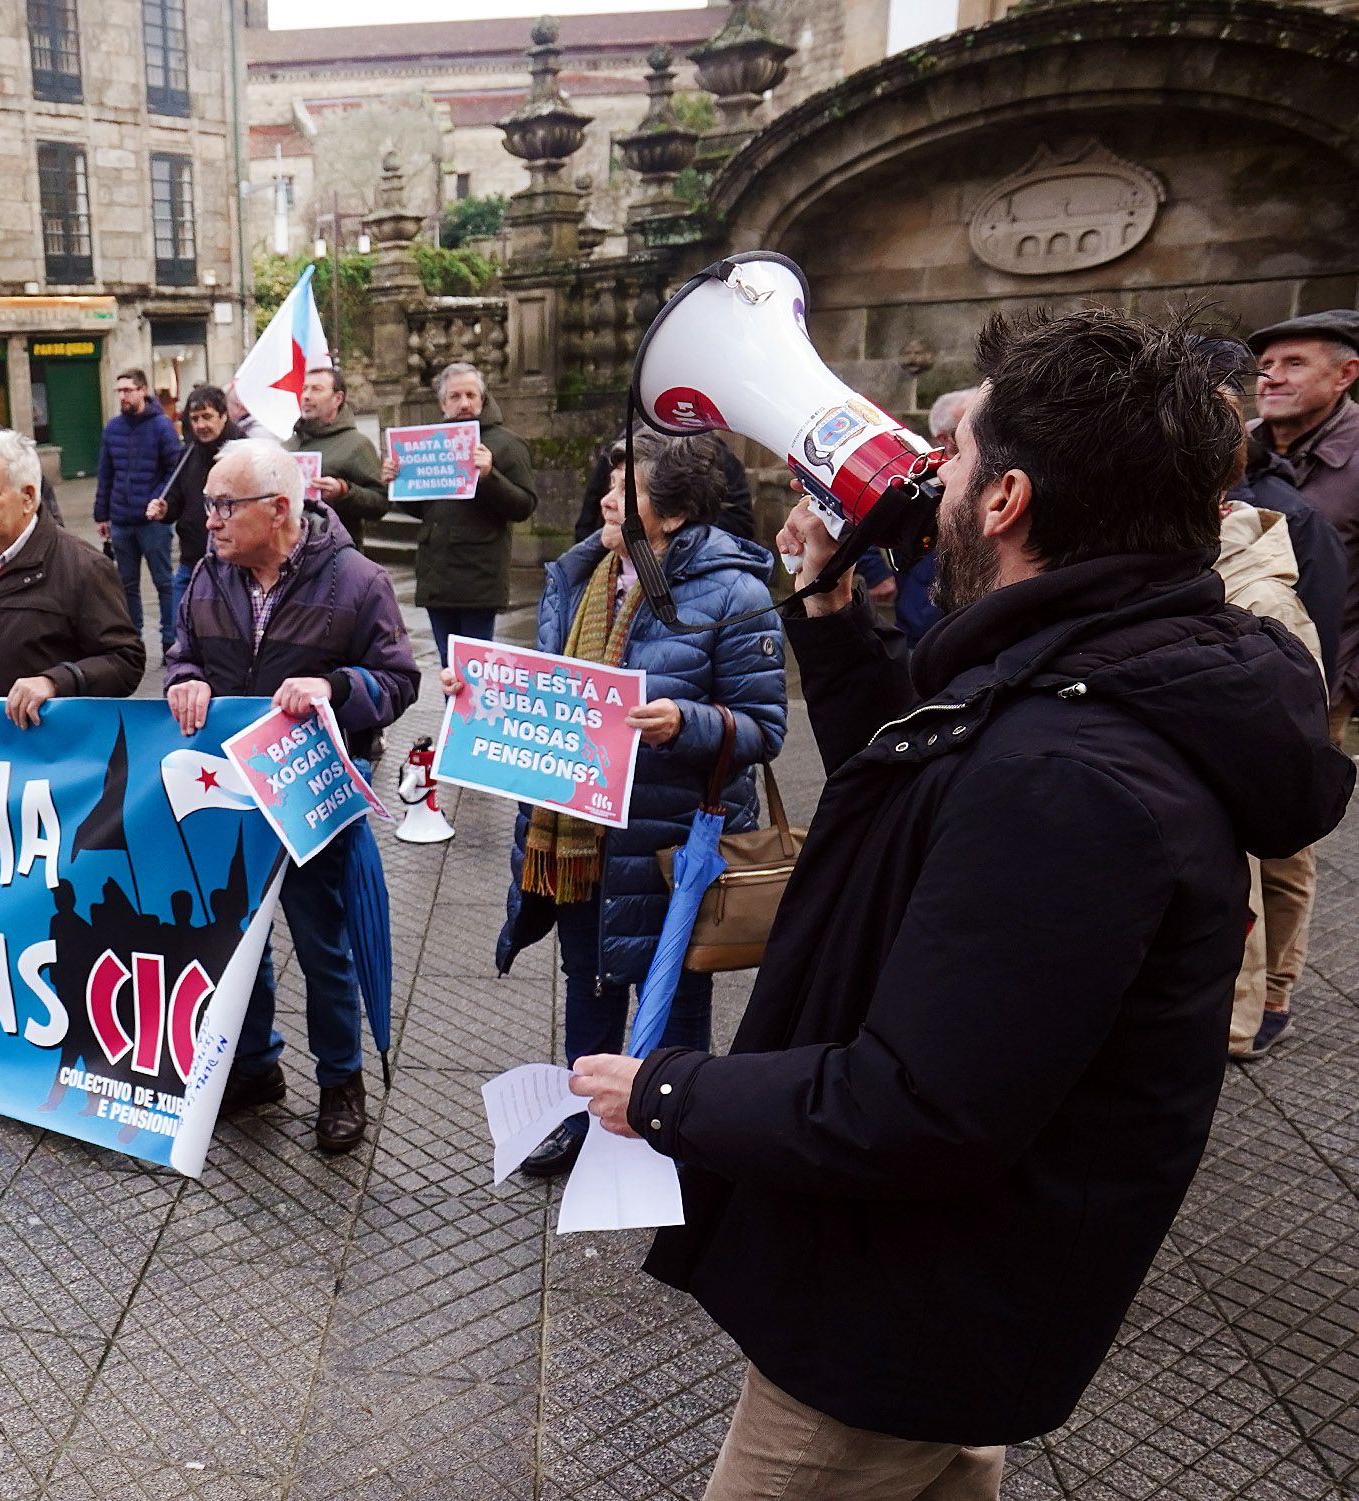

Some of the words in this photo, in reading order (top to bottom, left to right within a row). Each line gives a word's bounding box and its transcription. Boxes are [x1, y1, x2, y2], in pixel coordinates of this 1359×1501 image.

[399, 452, 437, 465] XOGAR
[403, 440, 441, 452] BASTA
[417, 465, 454, 476] NOSAS
[467, 659, 530, 688] ONDE
[536, 671, 599, 701] ESTÁ
[605, 687, 623, 707] A
[484, 688, 548, 718] SUBA
[555, 701, 603, 729] DAS
[502, 716, 580, 752] NOSAS
[266, 741, 332, 795] XOGAR
[307, 761, 346, 796] NOS
[472, 736, 600, 786] PENSIÓNS?
[59, 1066, 132, 1102] COLECTIVO
[134, 1086, 154, 1108] DE
[97, 1098, 109, 1117] E
